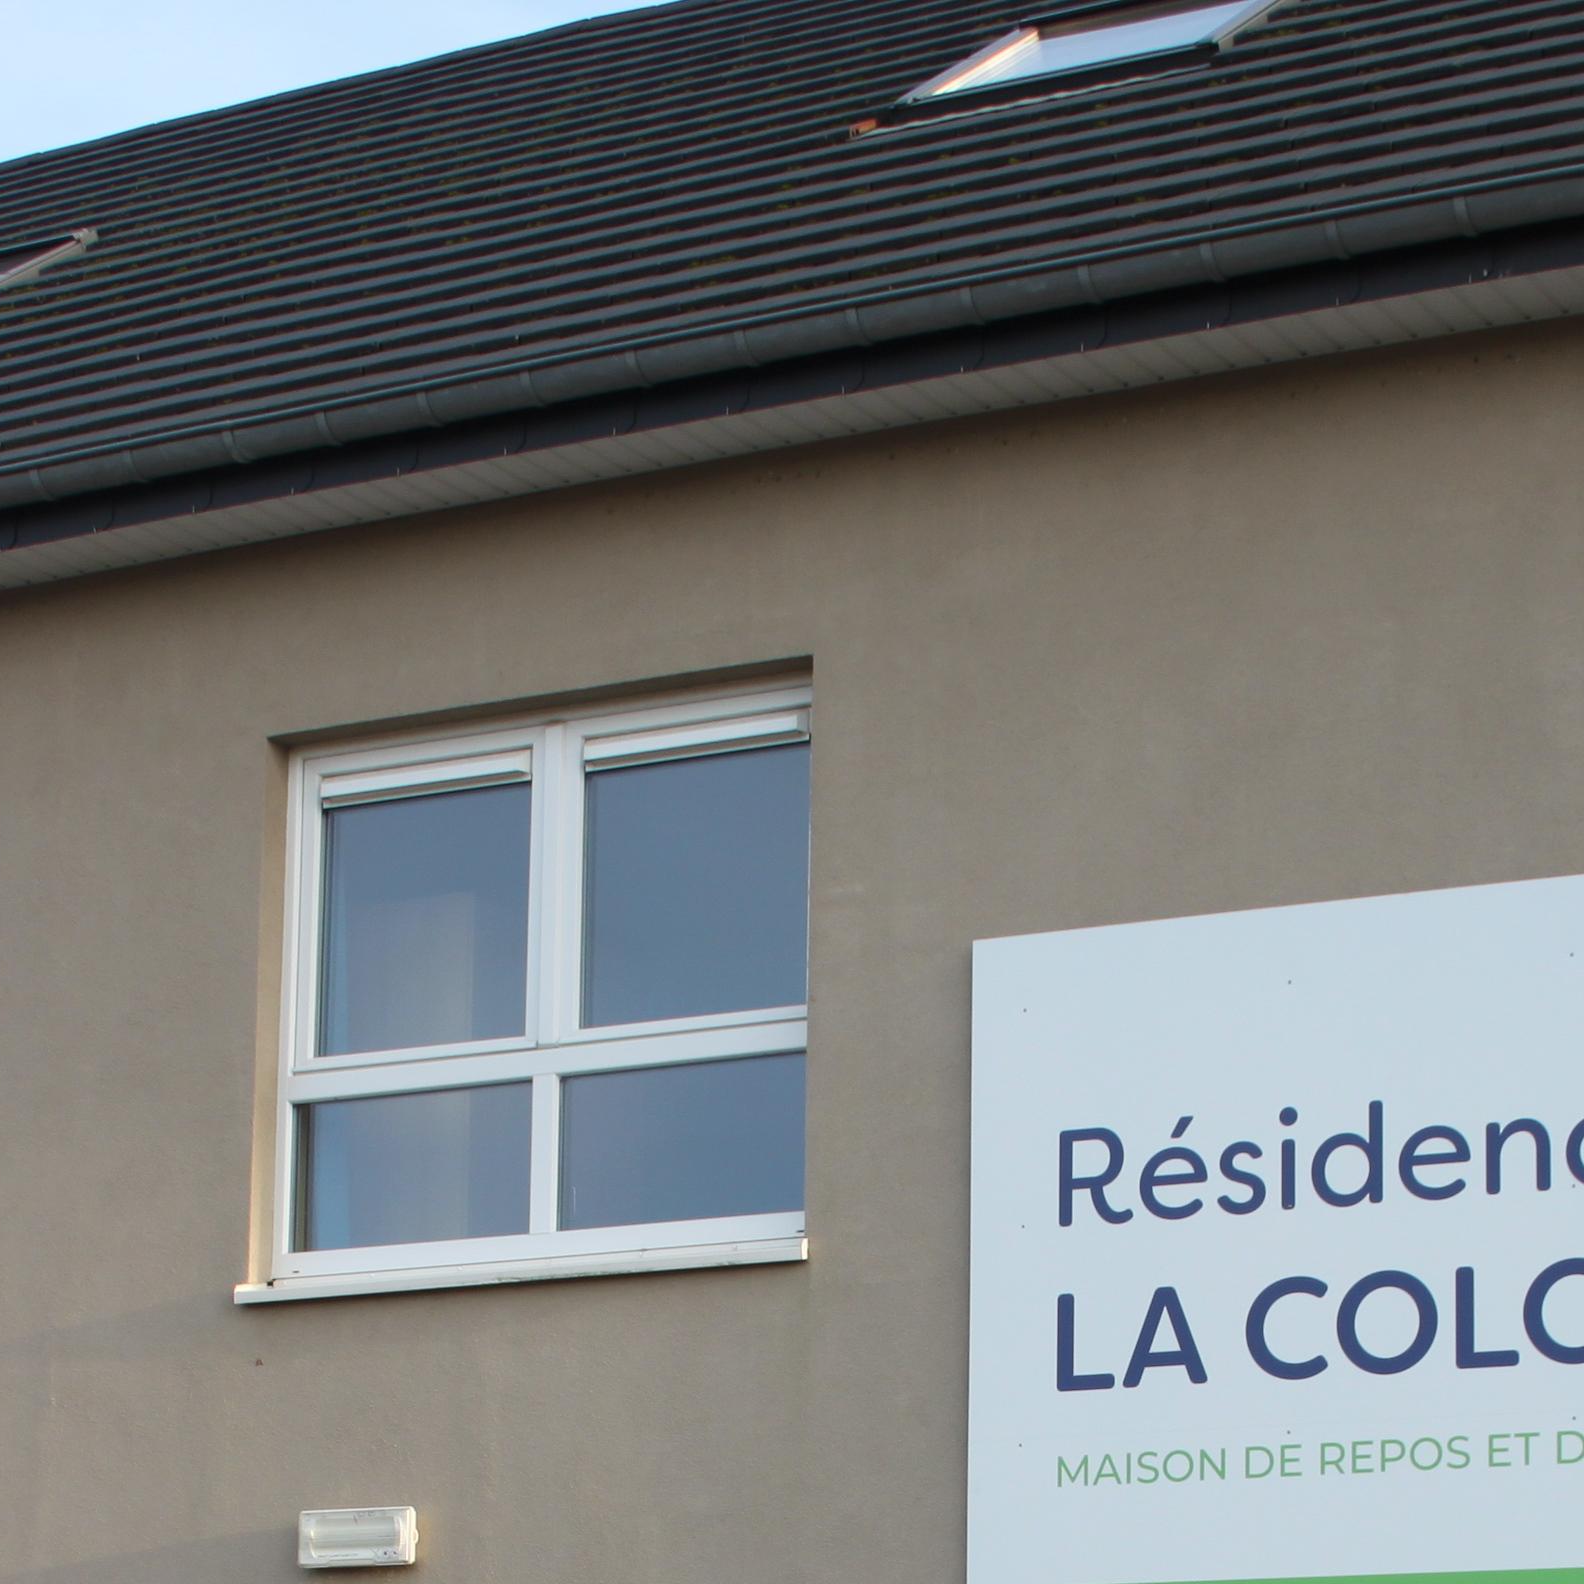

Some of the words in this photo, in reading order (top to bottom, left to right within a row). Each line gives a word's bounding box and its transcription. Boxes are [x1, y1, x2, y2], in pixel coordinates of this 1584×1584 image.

[1056, 1286, 1208, 1393] LA
[1055, 1447, 1227, 1488] MAISON
[1243, 1443, 1304, 1480] DE
[1318, 1434, 1473, 1476] REPOS
[1486, 1431, 1542, 1468] ET
